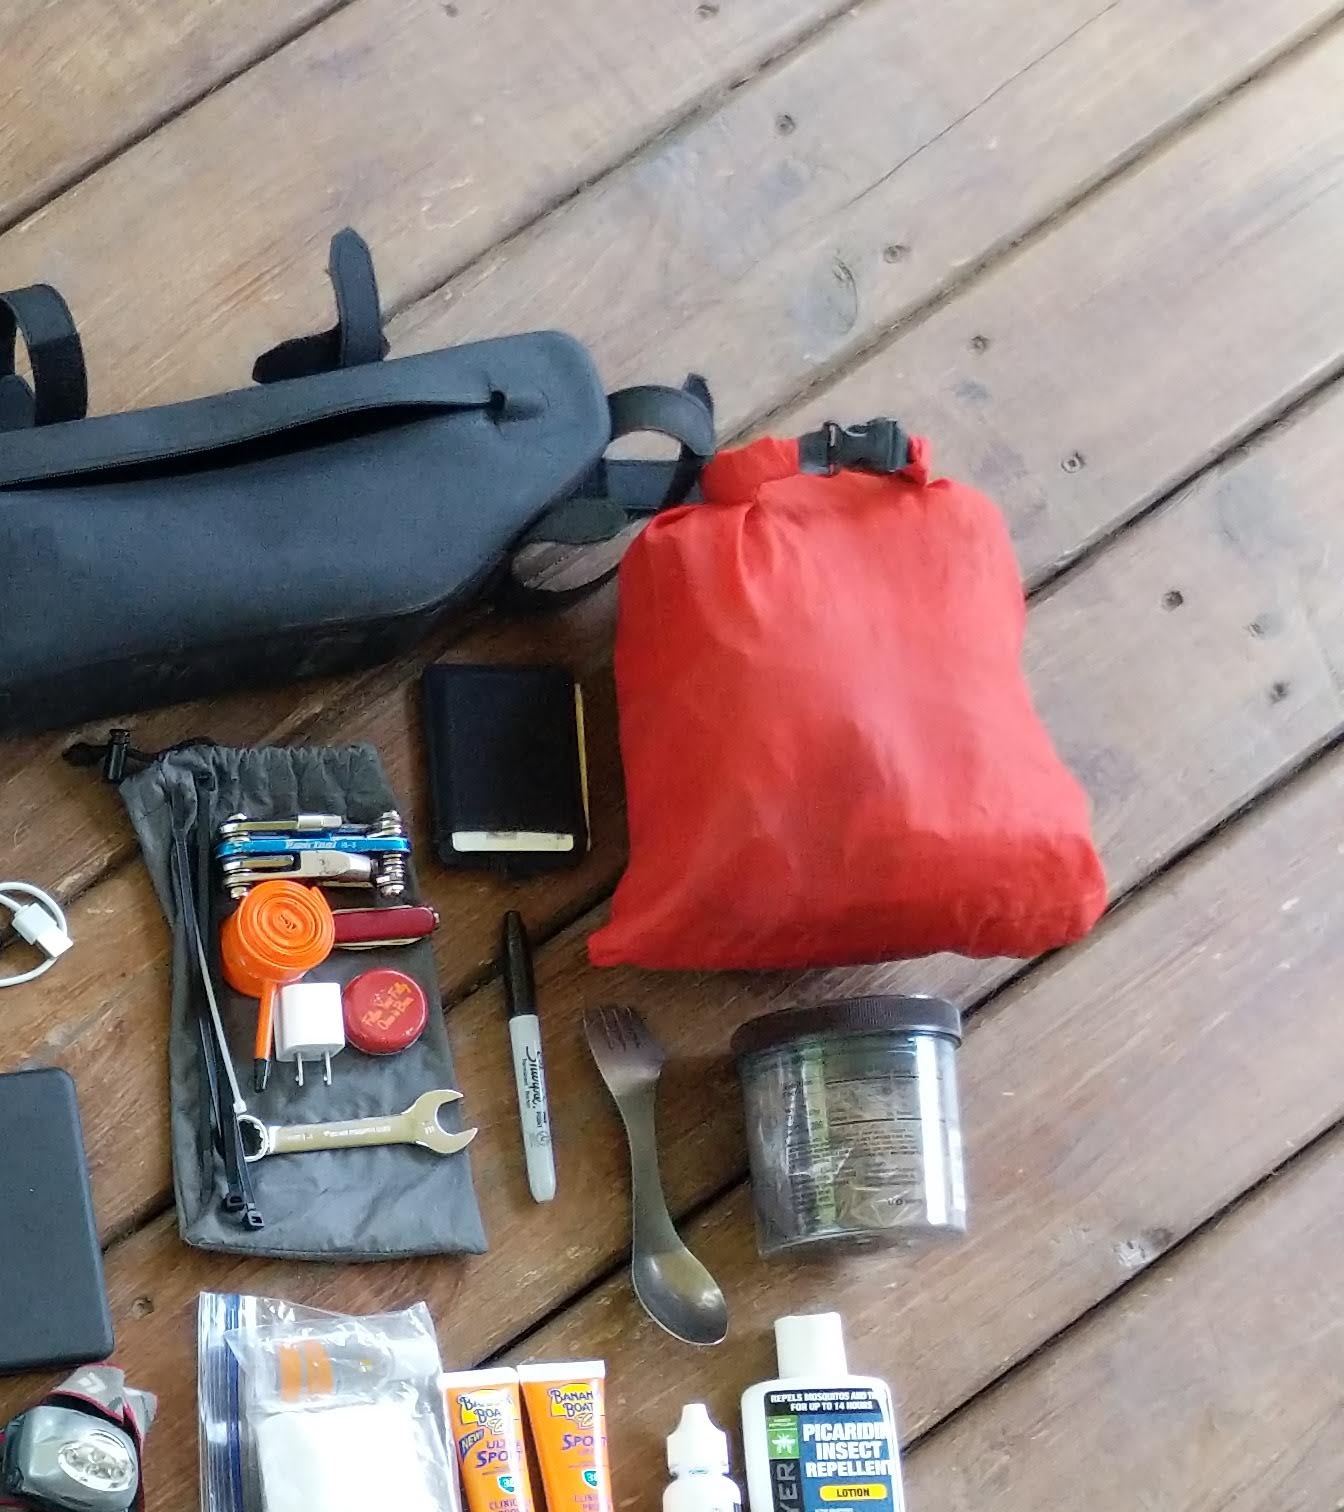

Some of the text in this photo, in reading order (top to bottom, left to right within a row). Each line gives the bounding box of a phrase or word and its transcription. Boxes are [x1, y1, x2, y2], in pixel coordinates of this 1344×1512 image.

[551, 1388, 595, 1404] BANAN
[790, 1402, 807, 1412] FOR
[809, 1402, 820, 1411] UP
[822, 1401, 832, 1411] TO
[473, 1408, 502, 1425] BOA
[460, 1431, 484, 1451] NEW
[562, 1434, 608, 1450] SPOT
[815, 1440, 883, 1460] INSECT
[836, 1487, 870, 1498] LOTION
